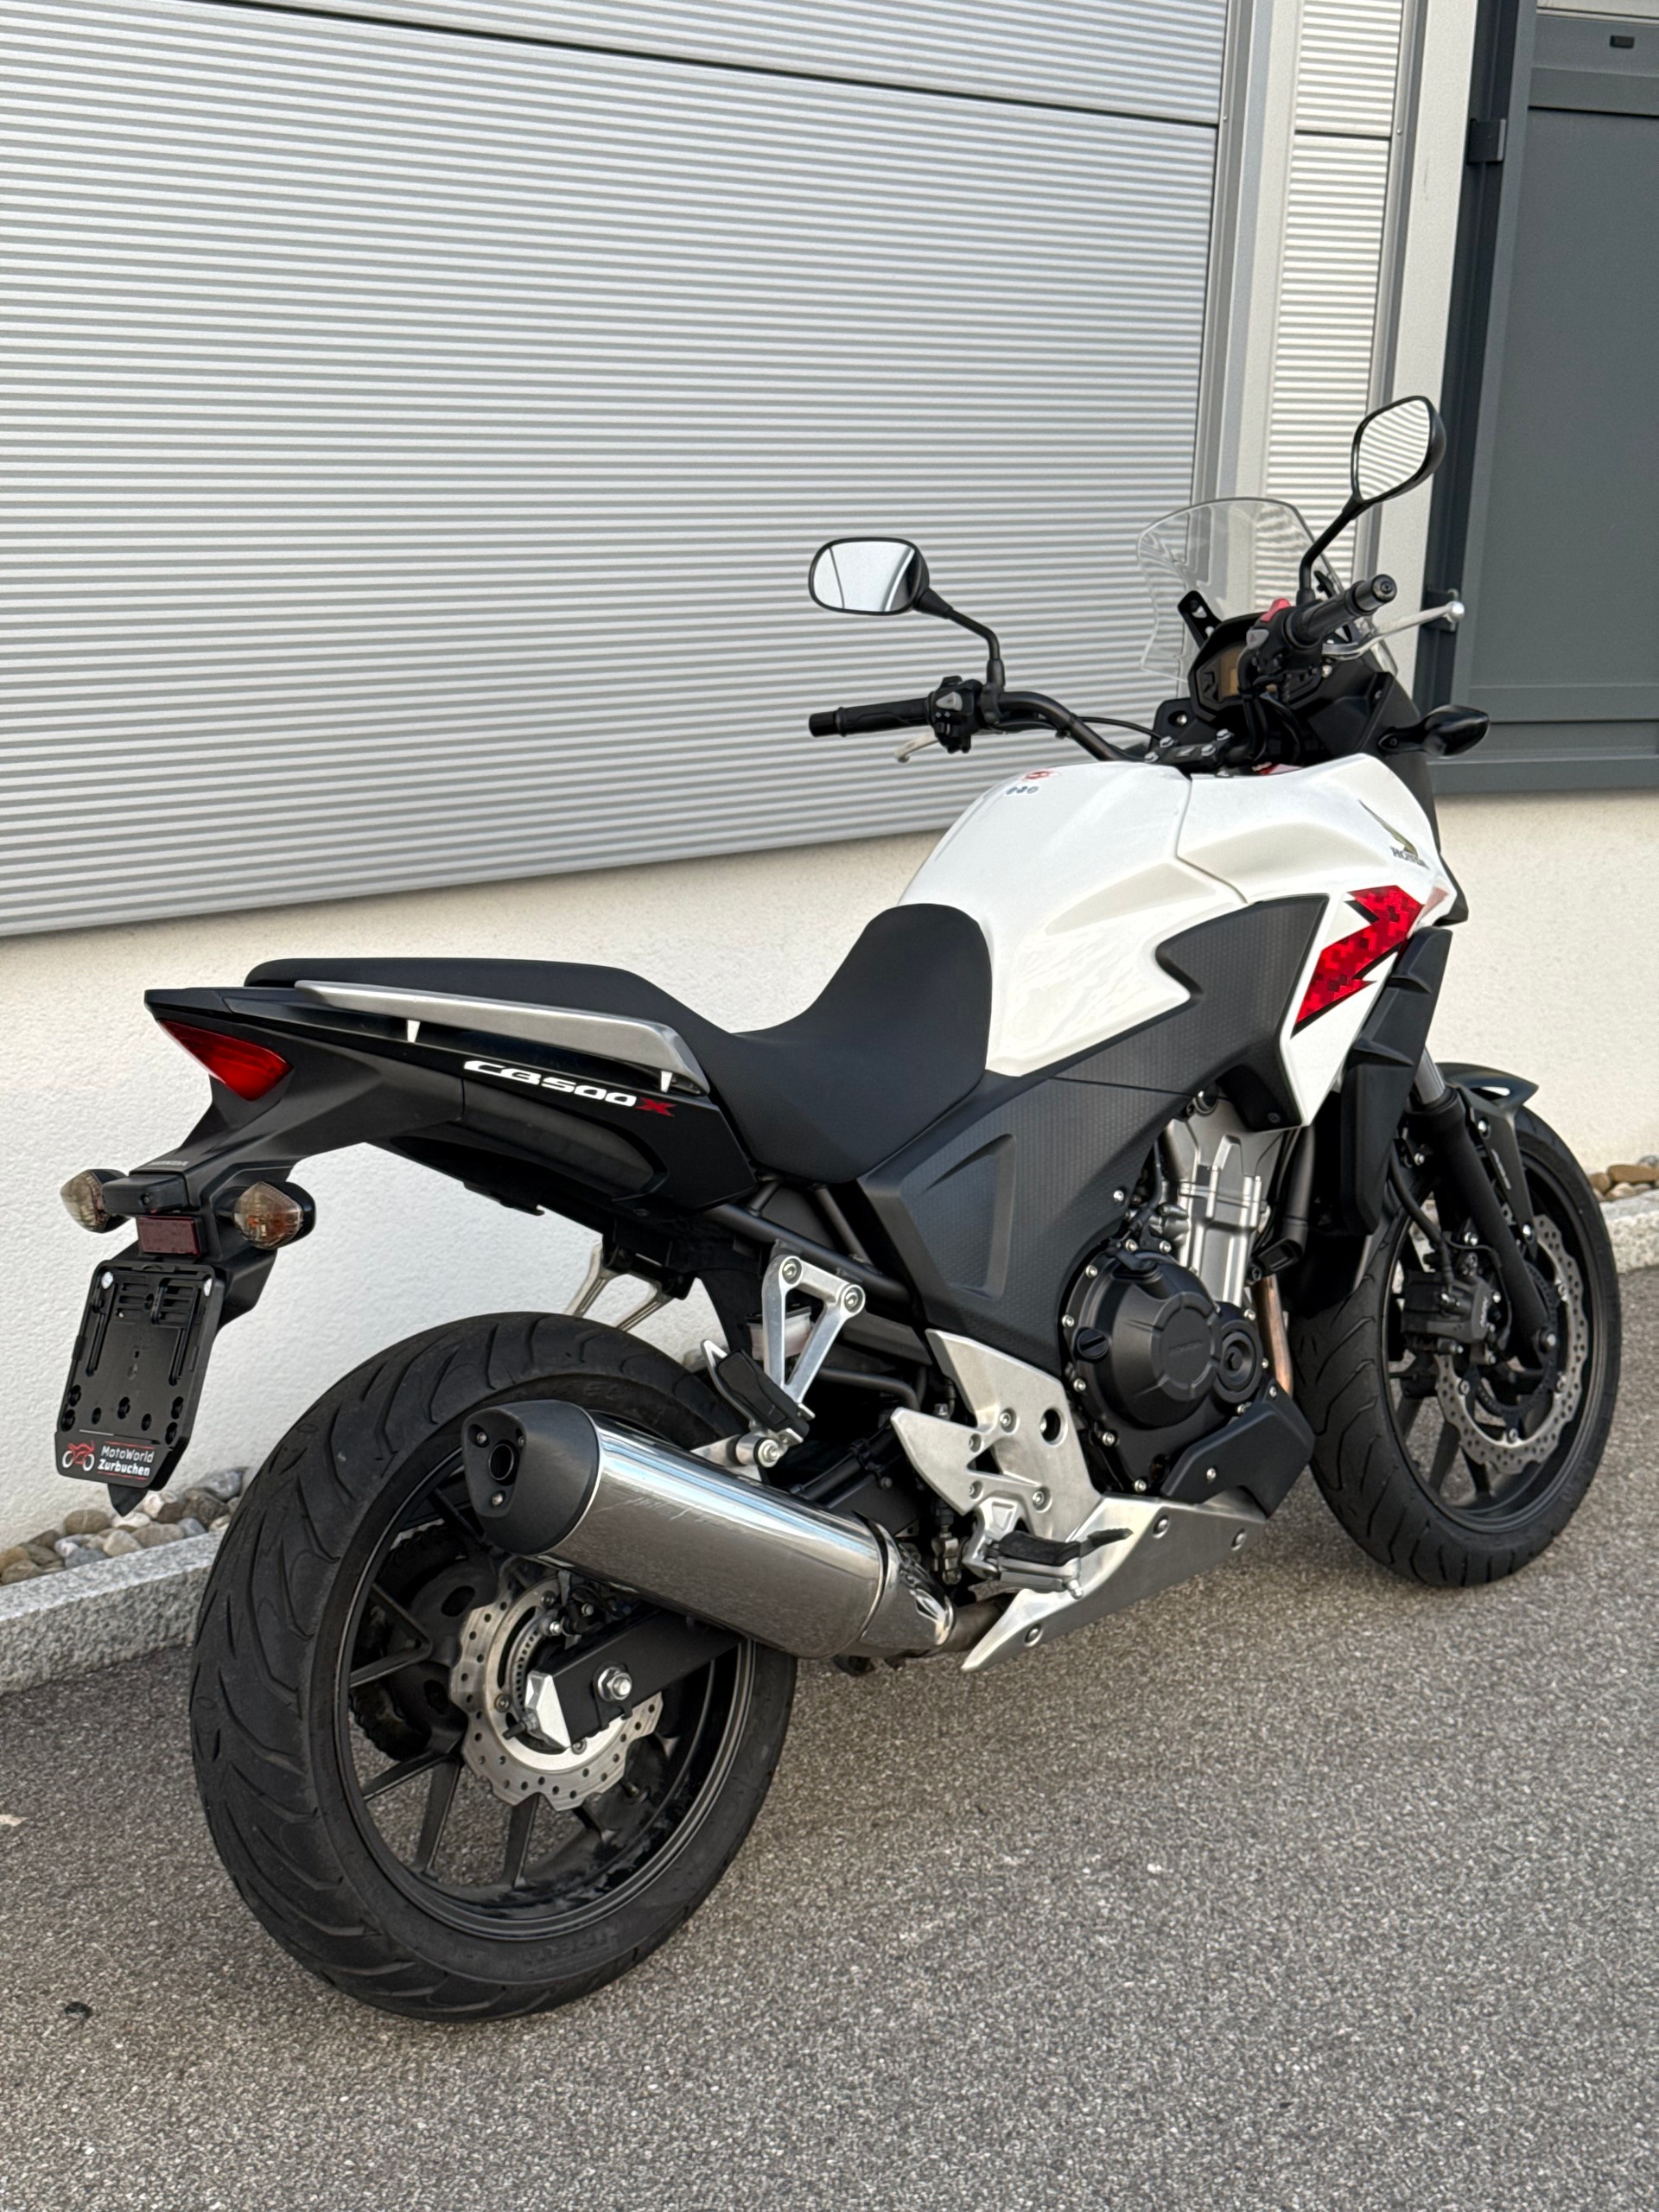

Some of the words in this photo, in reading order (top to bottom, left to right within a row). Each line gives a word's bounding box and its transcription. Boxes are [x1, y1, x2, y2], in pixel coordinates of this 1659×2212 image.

[463, 1060, 677, 1117] CB500X
[100, 1445, 155, 1464] MotoWorld
[97, 1459, 150, 1477] Zurbuchen
